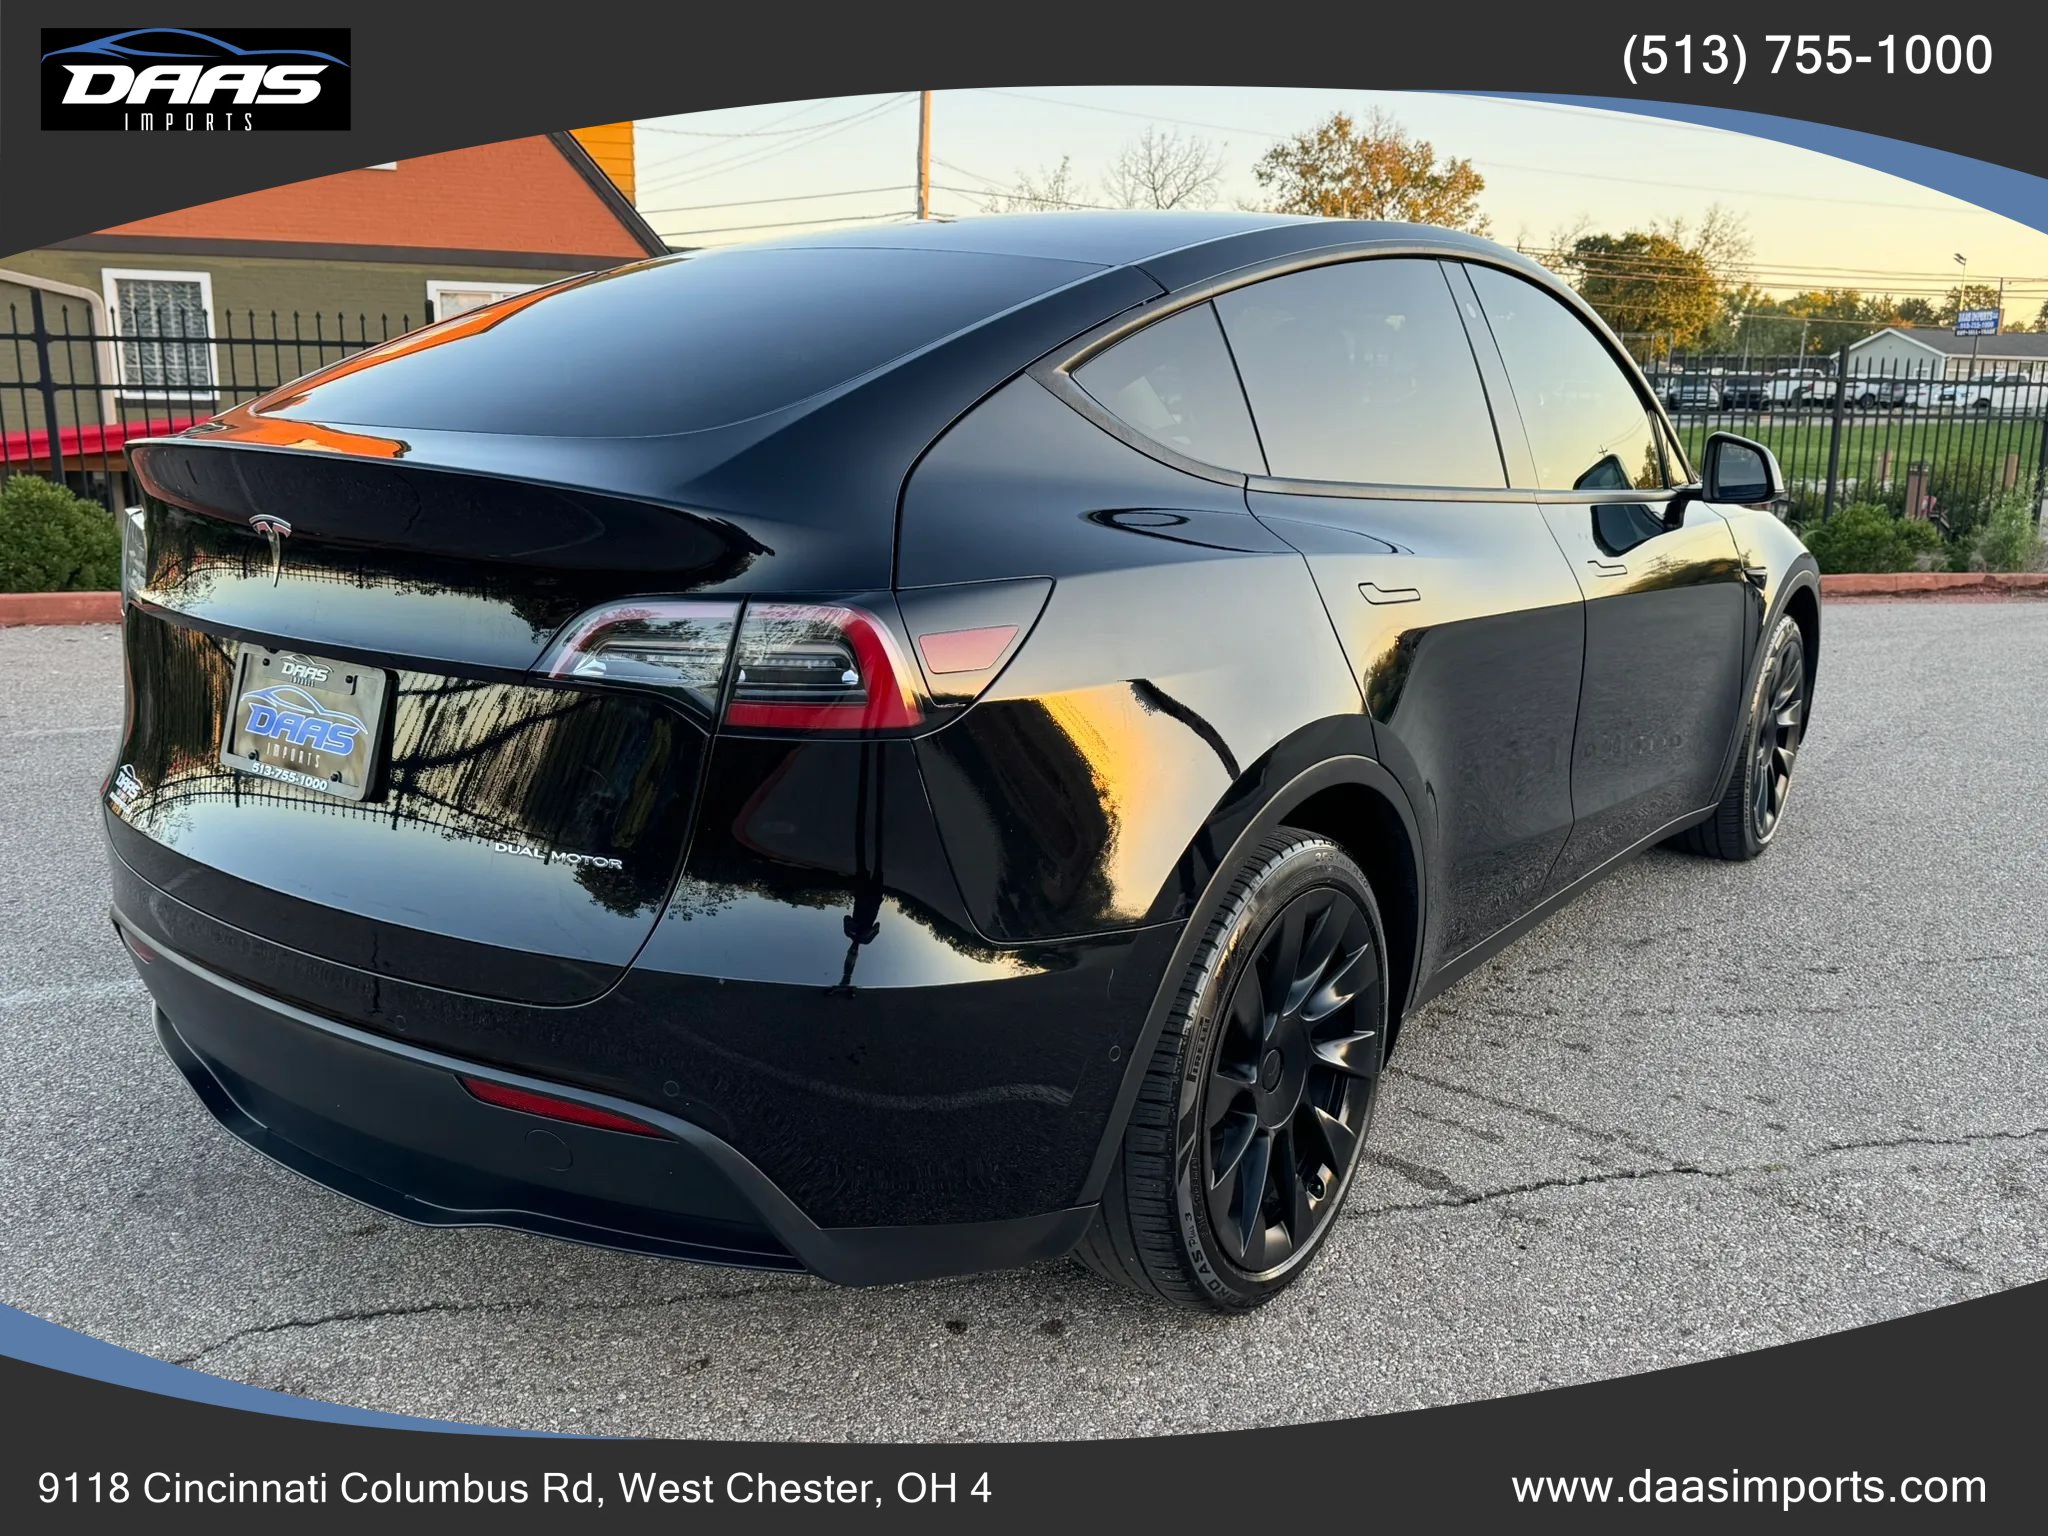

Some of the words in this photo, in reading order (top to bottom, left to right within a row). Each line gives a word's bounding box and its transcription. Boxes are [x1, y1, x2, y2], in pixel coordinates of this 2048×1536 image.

[281, 661, 329, 682] DAAS
[245, 703, 360, 756] DAAS
[494, 842, 546, 859] DUAL
[551, 850, 623, 870] MOTOR
